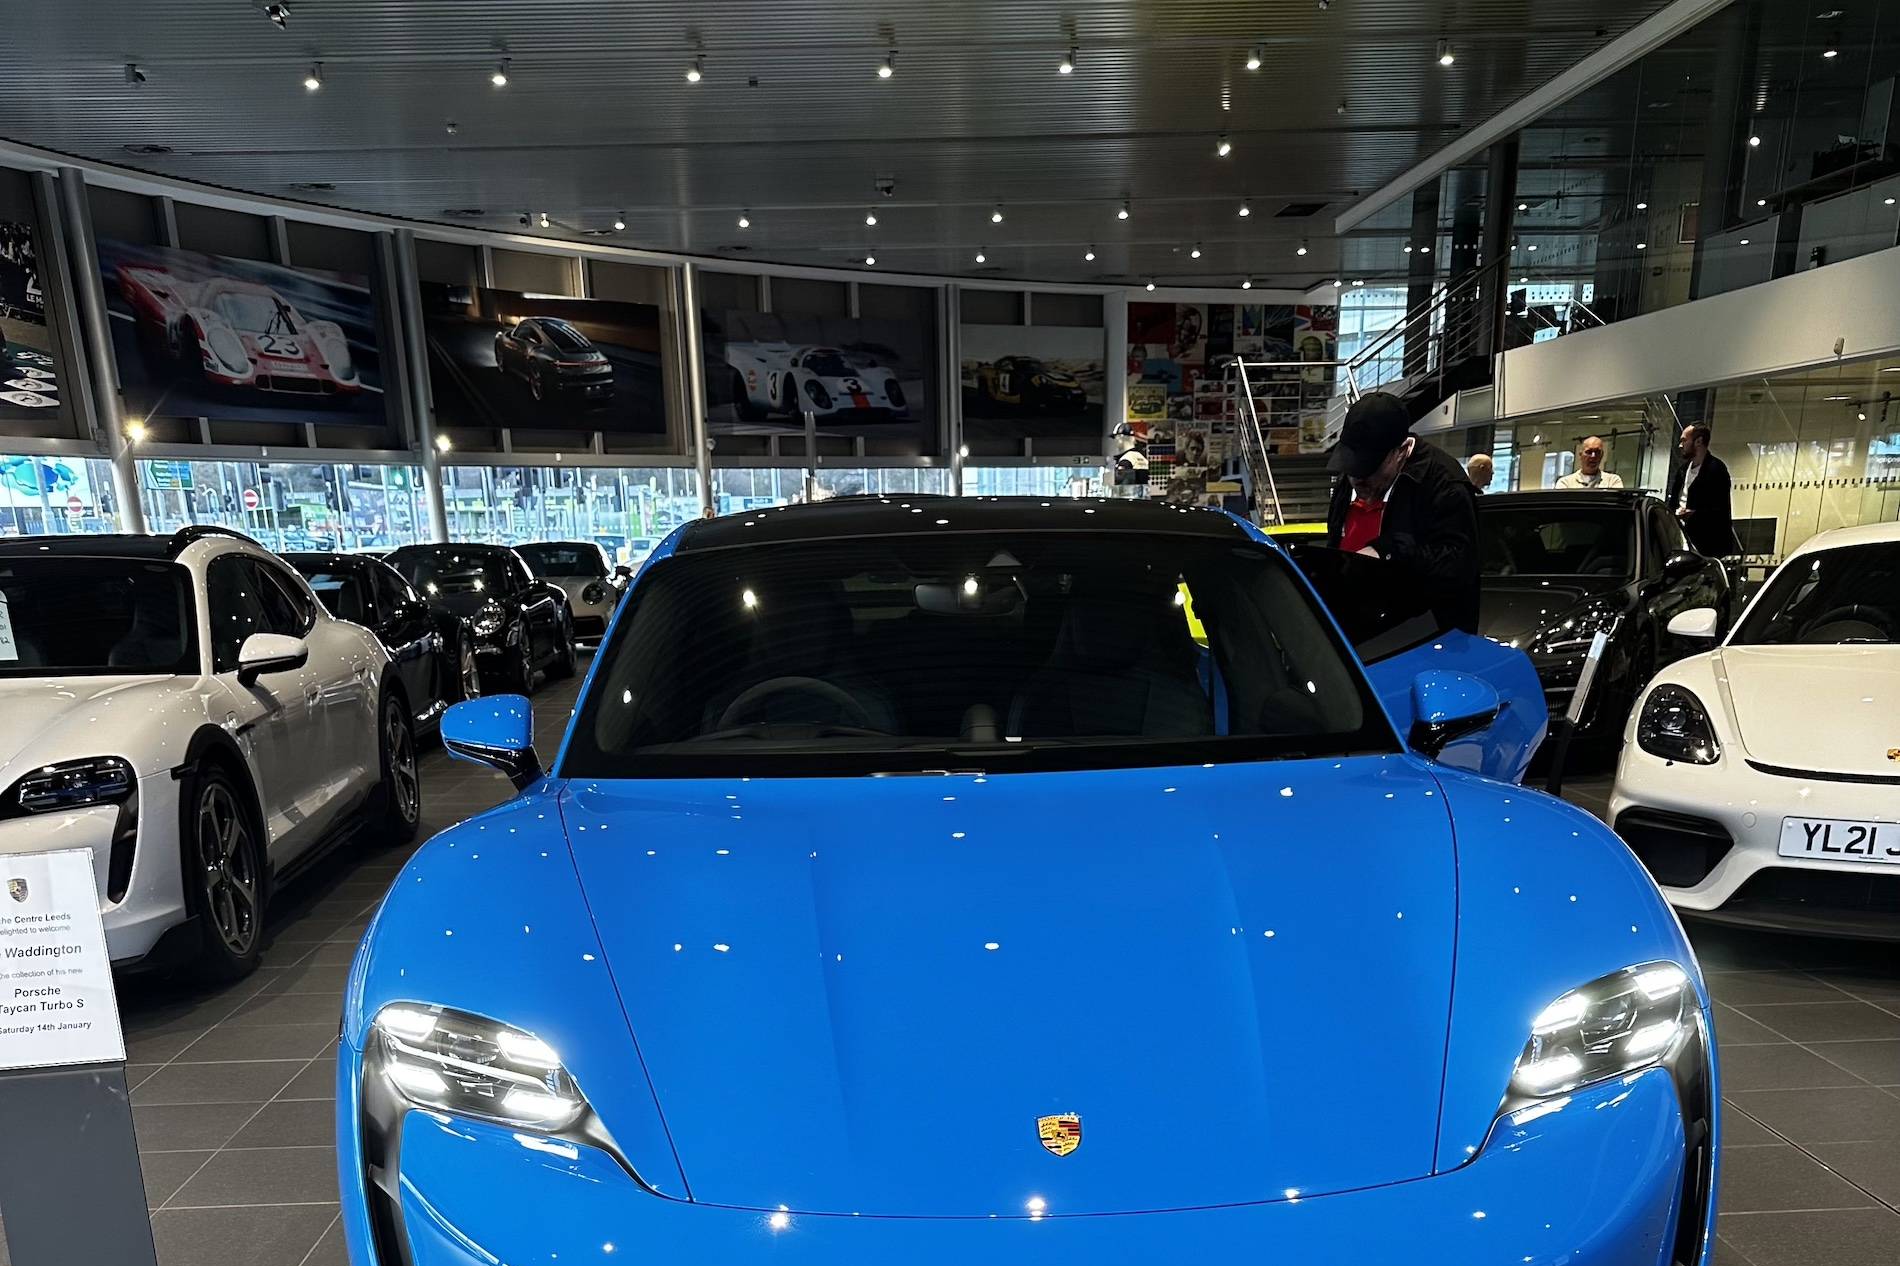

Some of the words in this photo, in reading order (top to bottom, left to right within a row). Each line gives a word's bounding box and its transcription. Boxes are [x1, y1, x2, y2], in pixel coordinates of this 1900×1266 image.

[258, 334, 299, 355] 23
[770, 372, 777, 401] 3
[843, 378, 862, 393] 3
[1803, 822, 1877, 855] YL21
[14, 915, 43, 924] Centre
[45, 913, 71, 922] Leeds
[38, 925, 71, 933] welcome
[5, 945, 82, 958] Waddington
[14, 986, 61, 998] Porsche
[0, 1004, 37, 1016] Taycan
[40, 1000, 73, 1011] Turbo
[76, 998, 85, 1008] S
[37, 1023, 56, 1032] 14th
[57, 1021, 92, 1031] January
